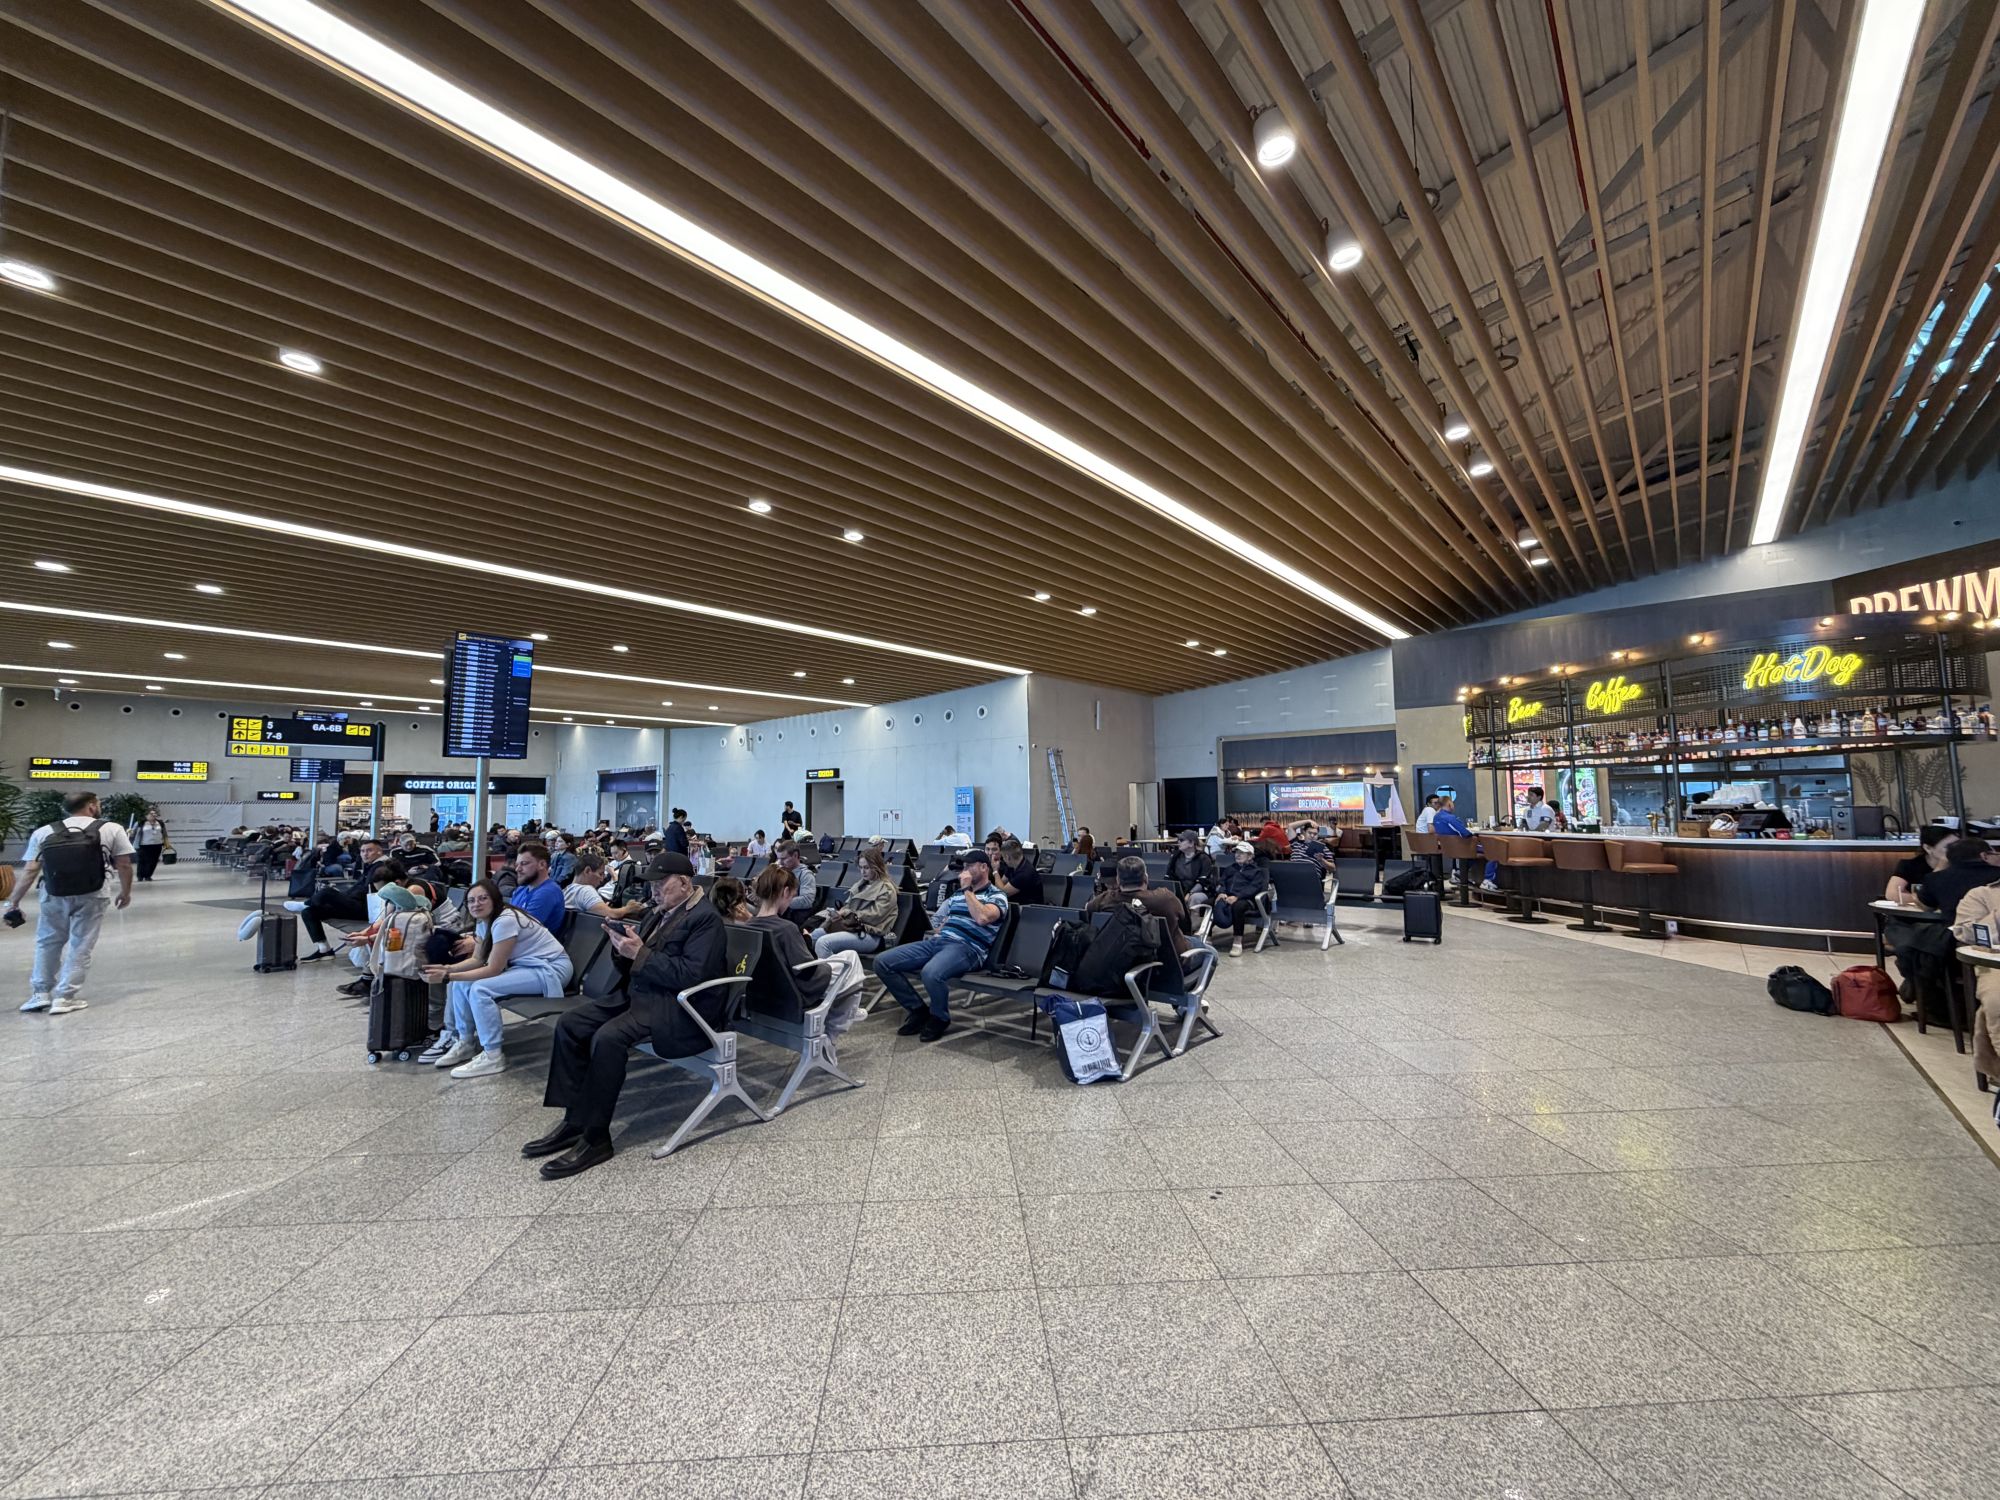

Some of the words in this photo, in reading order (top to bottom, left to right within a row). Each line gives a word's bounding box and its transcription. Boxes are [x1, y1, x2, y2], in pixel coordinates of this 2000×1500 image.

[1744, 653, 1803, 689] Hot
[1800, 645, 1862, 685] Dog
[1586, 676, 1641, 714] Coffee
[1508, 697, 1542, 723] Beer
[267, 721, 274, 729] 5
[312, 723, 342, 732] 6A-6B
[266, 732, 282, 740] 7-8
[405, 780, 444, 789] COFFEE
[446, 781, 495, 789] ORIGIL
